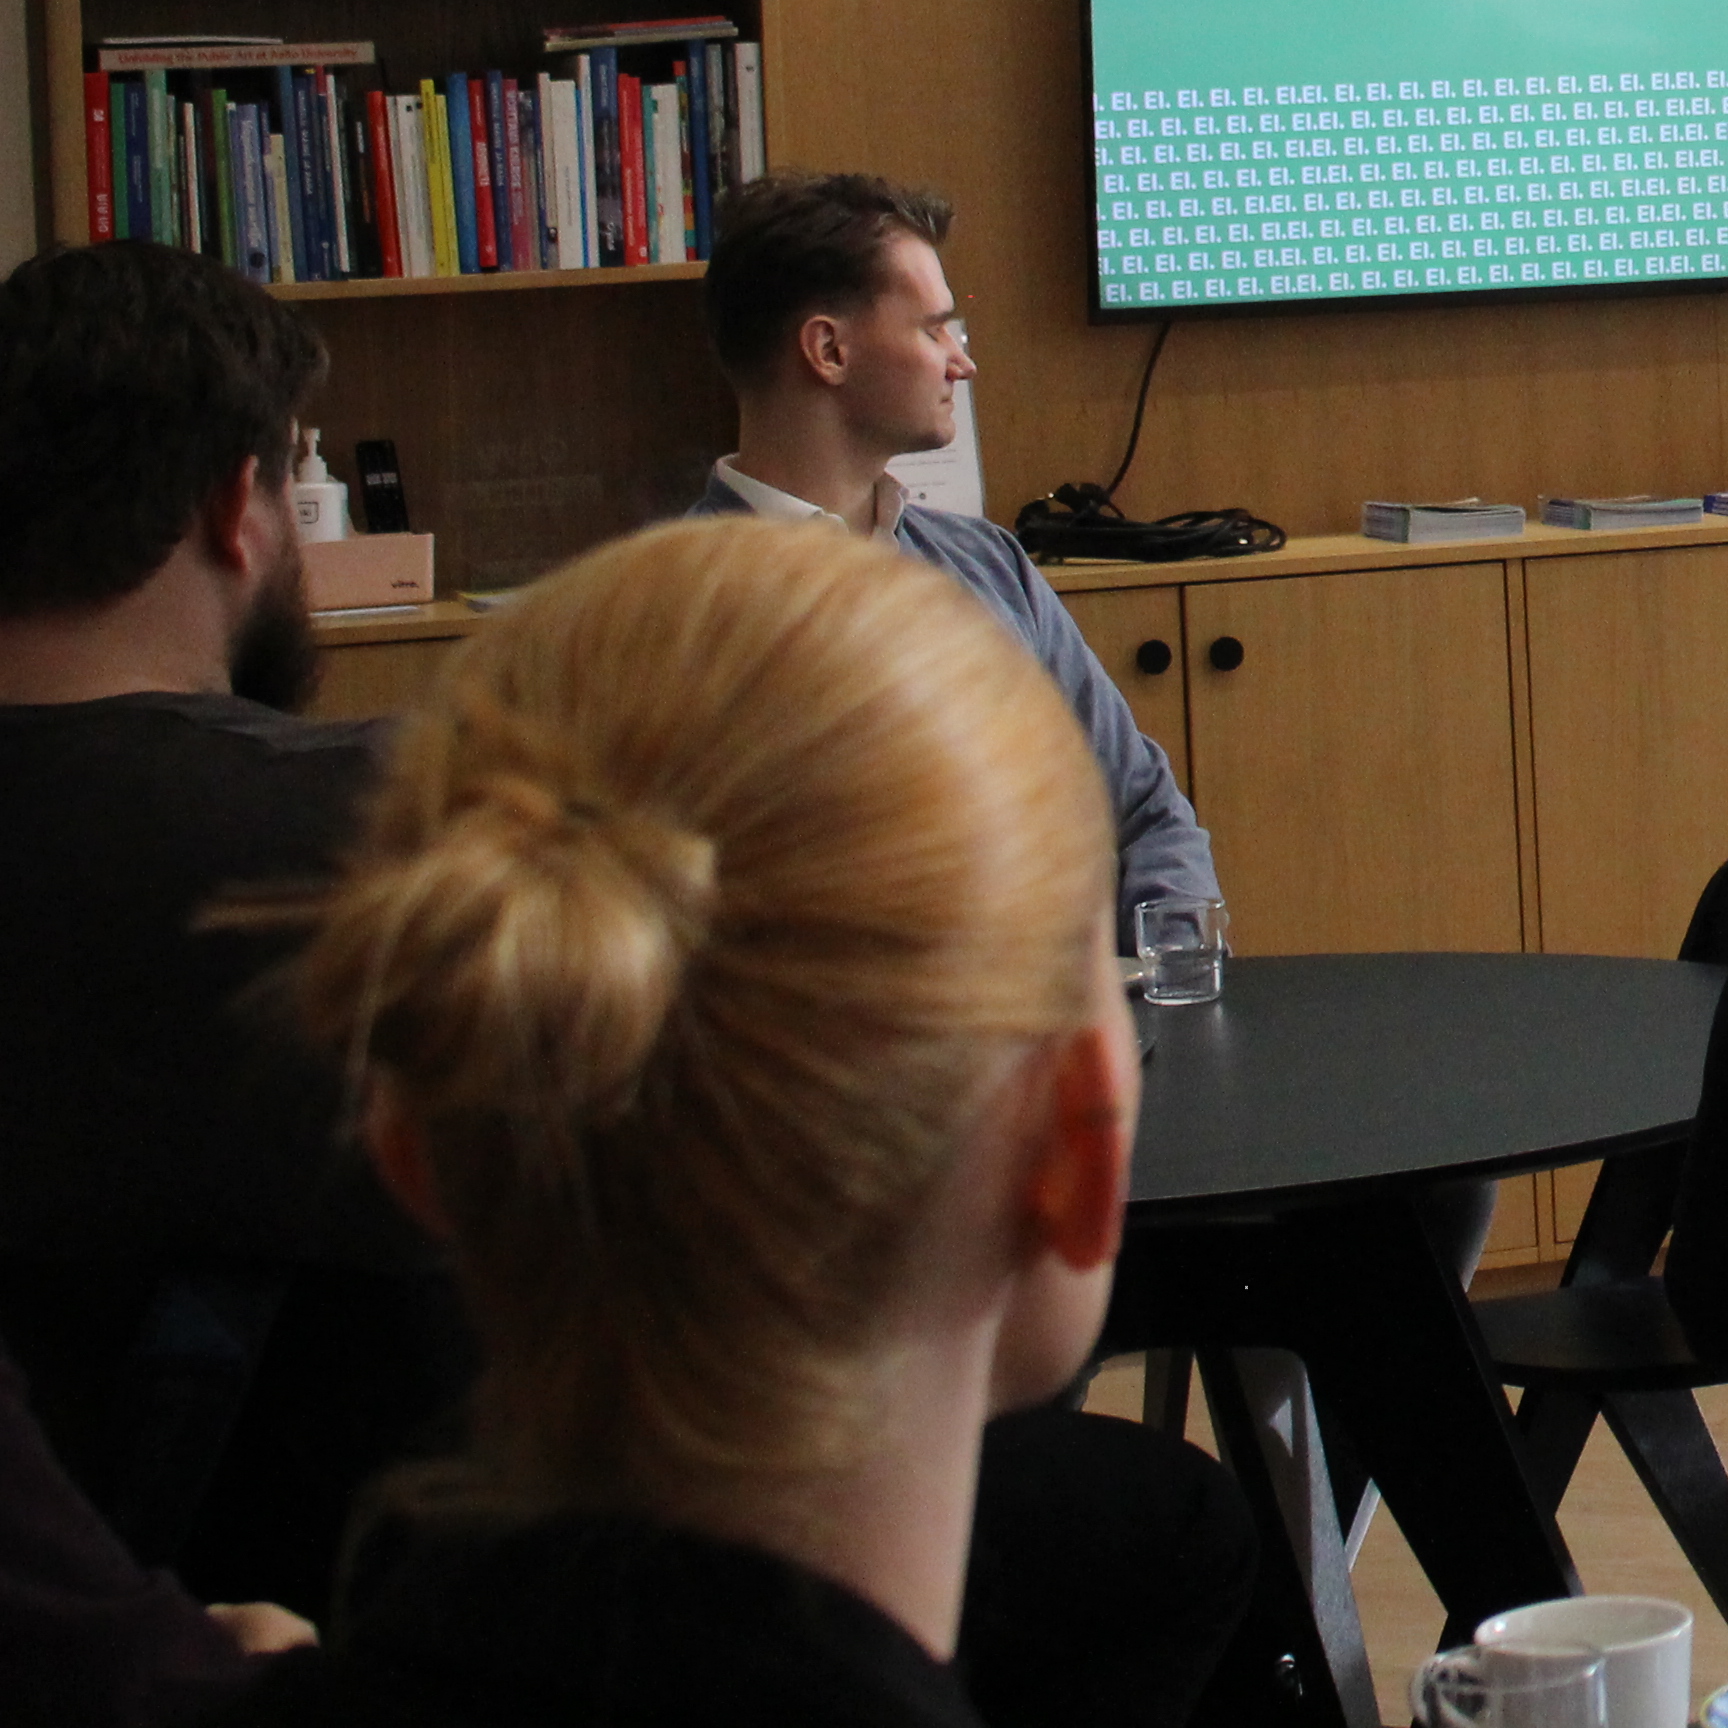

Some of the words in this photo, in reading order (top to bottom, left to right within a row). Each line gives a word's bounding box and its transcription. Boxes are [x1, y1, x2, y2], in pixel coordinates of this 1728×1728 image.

[1111, 91, 1138, 111] EI.
[1144, 91, 1171, 110] EI.
[1177, 90, 1204, 108] EI.
[1210, 88, 1236, 107] EI.
[1243, 87, 1269, 106] EI.
[1335, 84, 1361, 102] EI.
[1366, 83, 1392, 101] EI.
[1399, 82, 1425, 100] EI.
[1431, 80, 1456, 98] EI.
[1463, 79, 1488, 97] EI.
[1494, 78, 1520, 96] EI.
[1526, 77, 1551, 95] EI.
[1558, 76, 1582, 94] EI.
[1589, 75, 1613, 92] EI.
[1620, 74, 1644, 92] EI.
